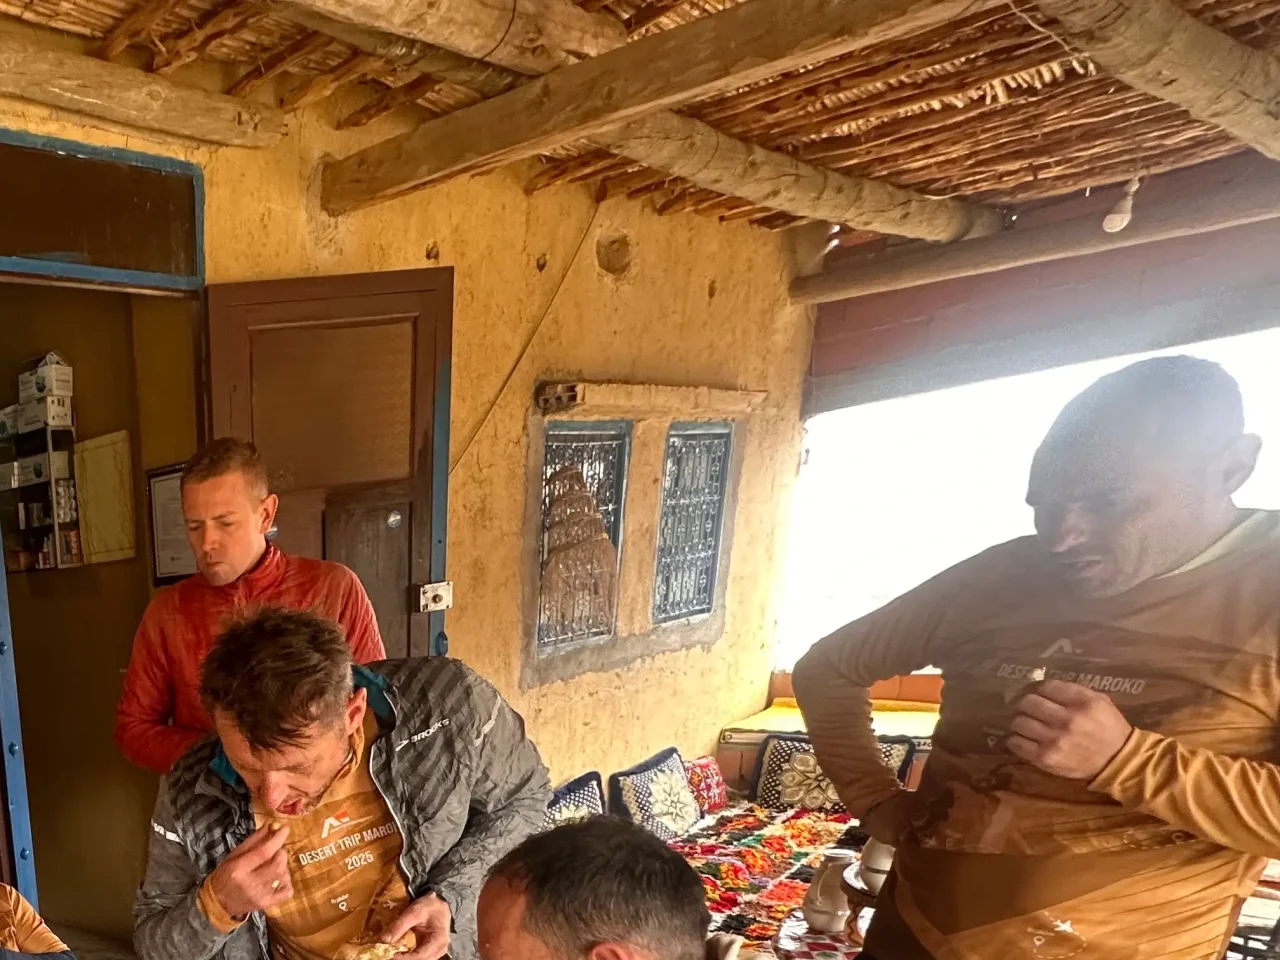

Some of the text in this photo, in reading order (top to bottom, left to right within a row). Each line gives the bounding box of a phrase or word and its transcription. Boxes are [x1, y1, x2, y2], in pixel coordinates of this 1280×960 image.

[411, 718, 450, 743] BROOKS
[298, 842, 337, 866] DESERT
[337, 832, 361, 851] TRIP
[362, 820, 398, 842] MARO
[345, 850, 374, 870] 2025
